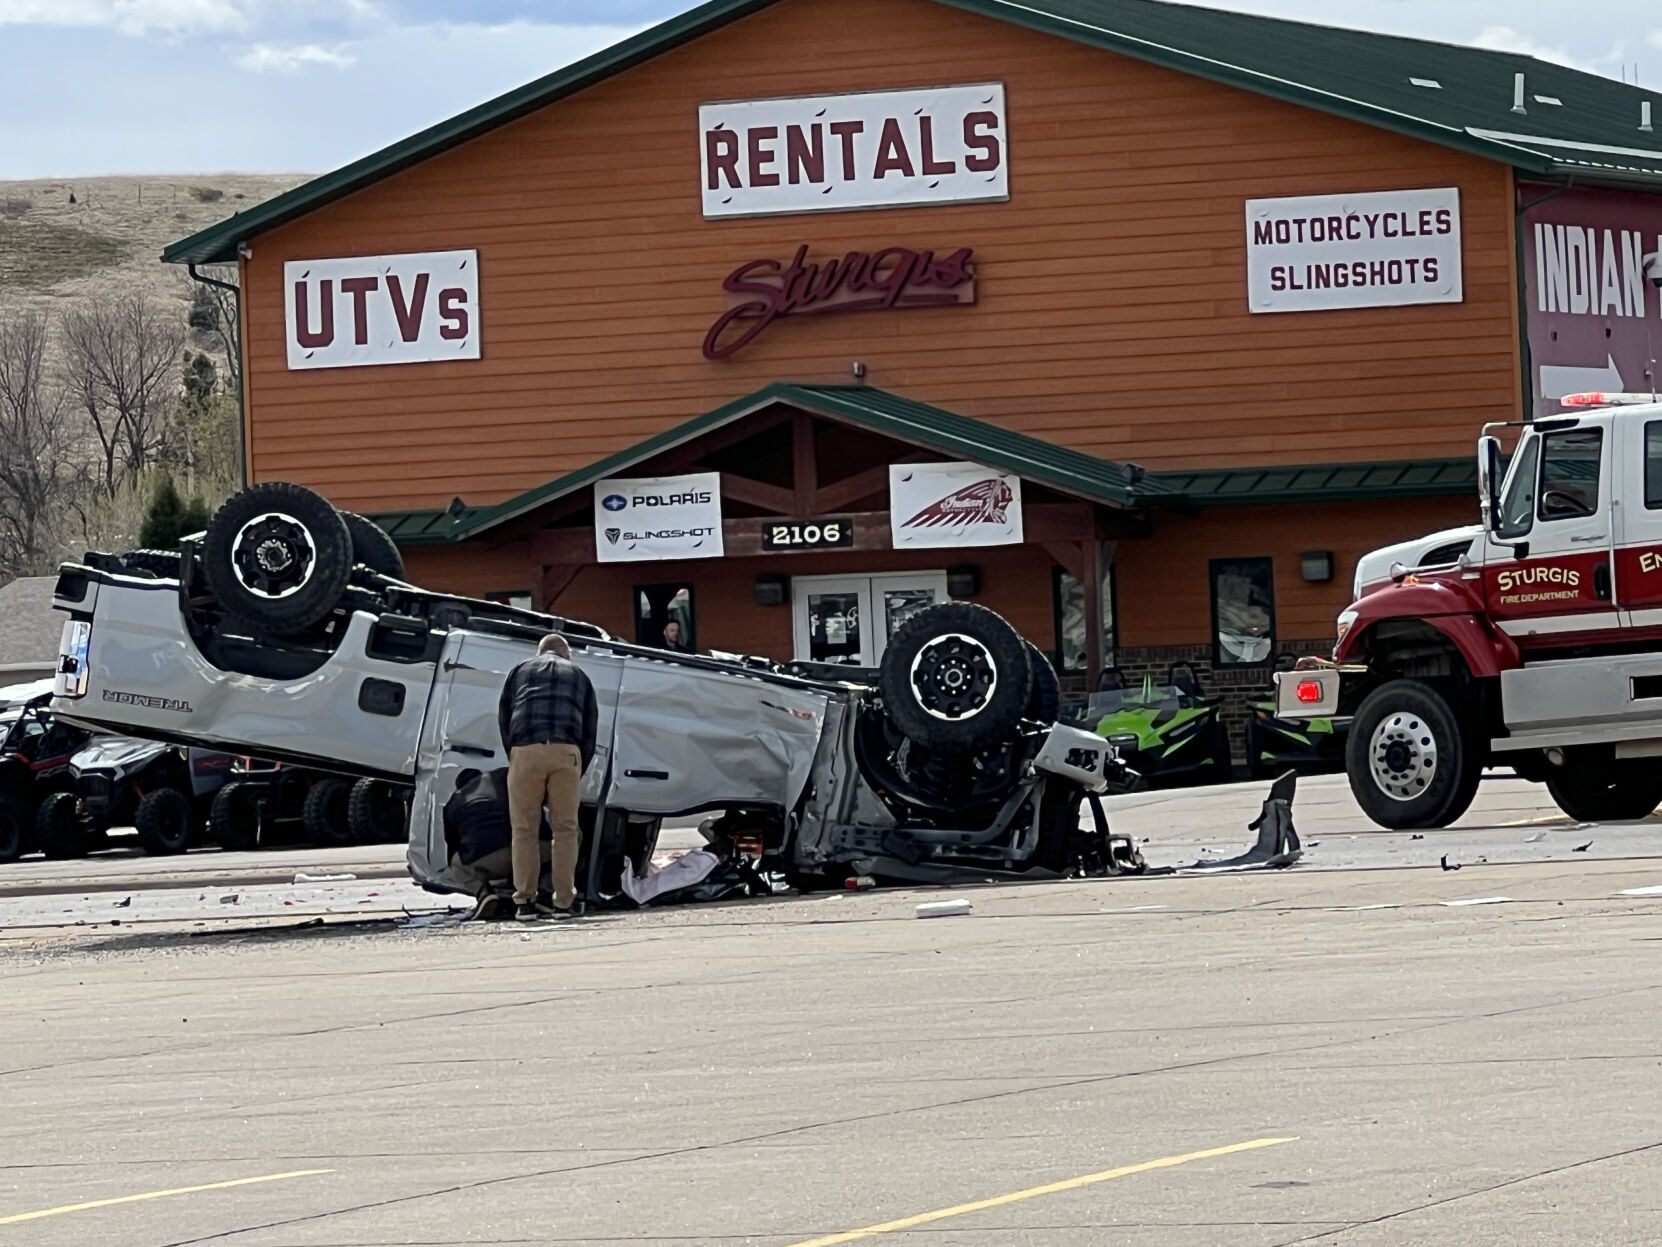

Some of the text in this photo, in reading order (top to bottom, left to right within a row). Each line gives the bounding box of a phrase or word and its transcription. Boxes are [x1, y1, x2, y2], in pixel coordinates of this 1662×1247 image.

[706, 110, 1001, 191] RENTALS
[1254, 209, 1452, 245] MOTORCYCLES
[1270, 257, 1439, 291] SLINGSHOTS
[1534, 223, 1645, 318] INDIAN
[294, 273, 469, 349] UTVs
[702, 244, 974, 360] Sturgis
[632, 491, 713, 508] POLARIS
[623, 527, 716, 541] SLINGSHOT
[771, 523, 841, 544] 2106
[1500, 589, 1579, 604] FIRE DEPARTMENT
[102, 688, 194, 712] TREMOR
